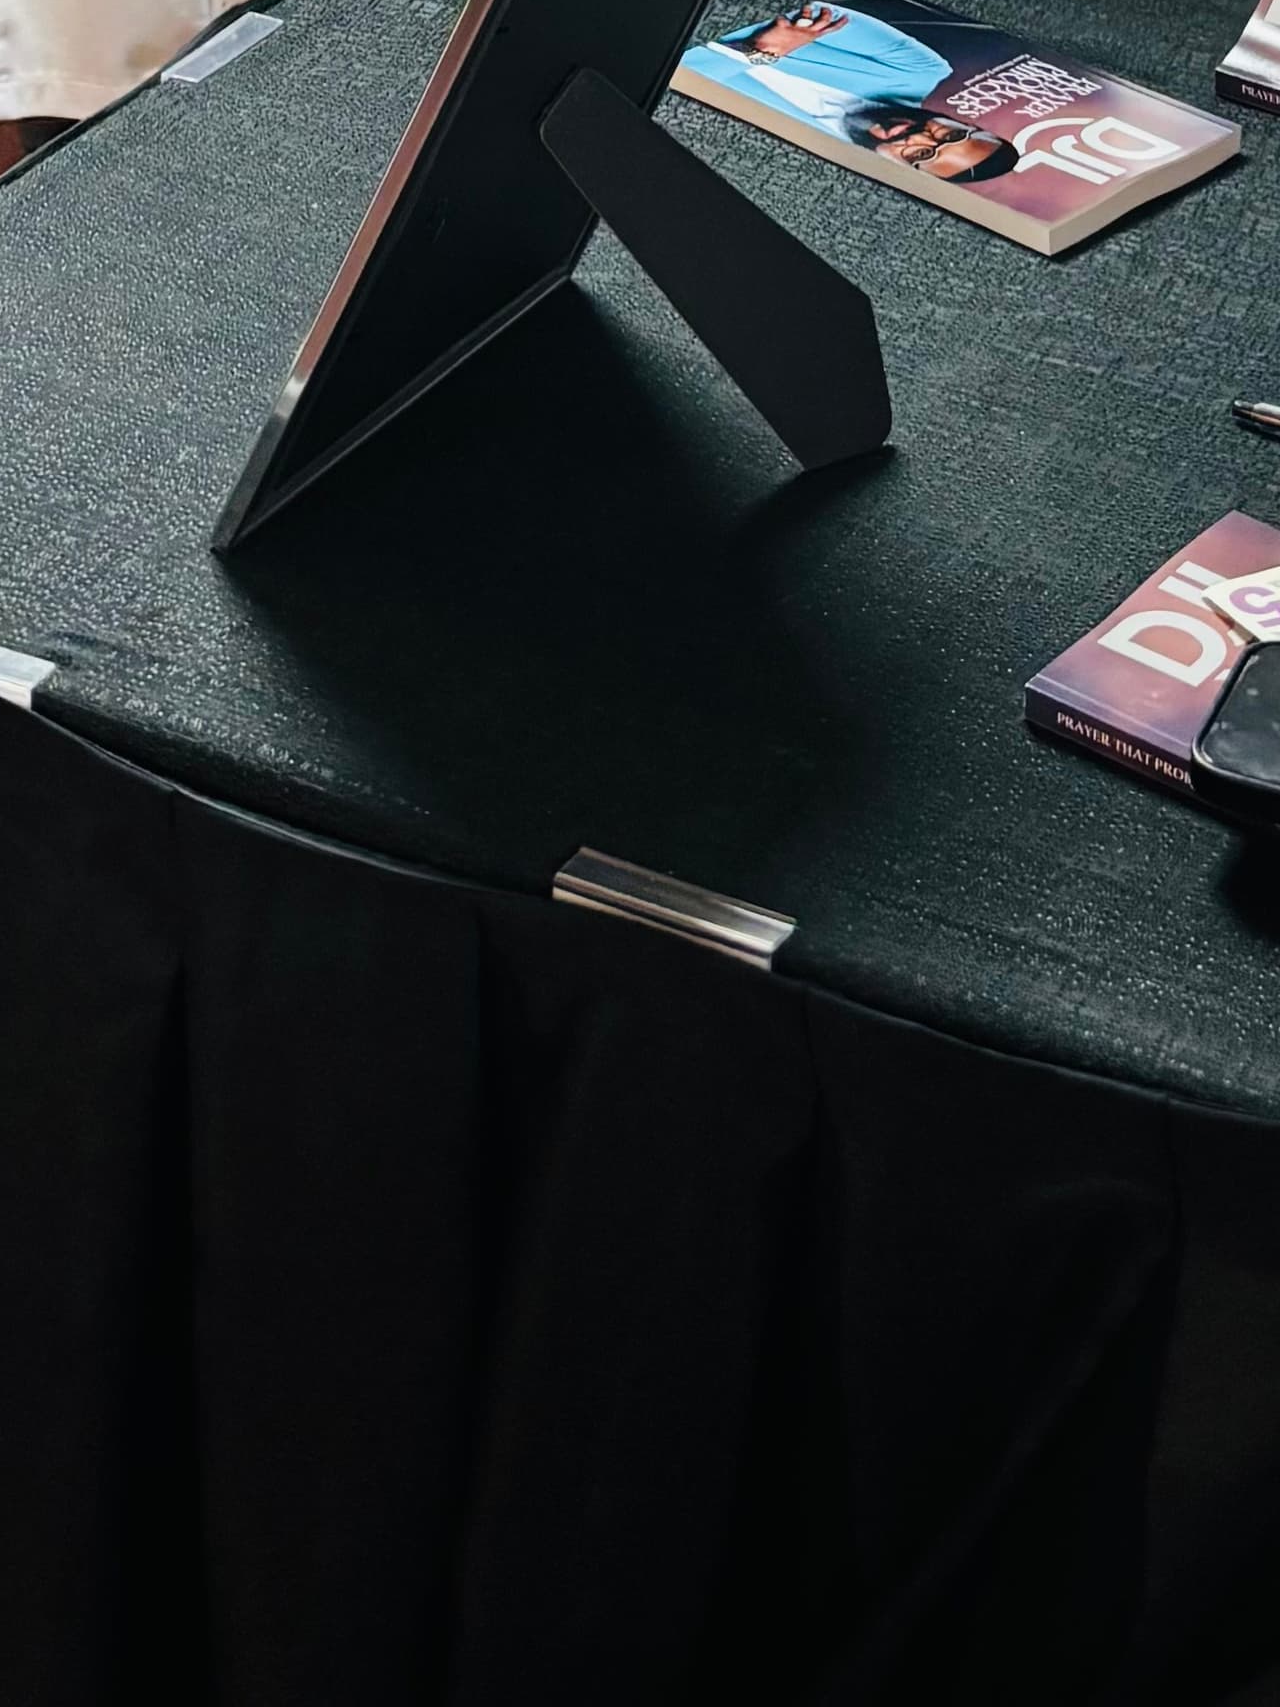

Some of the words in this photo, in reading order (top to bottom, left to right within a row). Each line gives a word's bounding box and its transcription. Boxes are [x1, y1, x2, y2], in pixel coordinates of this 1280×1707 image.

[946, 57, 1059, 109] MIRACLES
[956, 60, 1070, 119] PRODUCES
[1014, 76, 1103, 119] PRAYER
[1012, 116, 1182, 185] DJL
[1056, 710, 1110, 747] PRAYER
[1111, 734, 1153, 768] THAT
